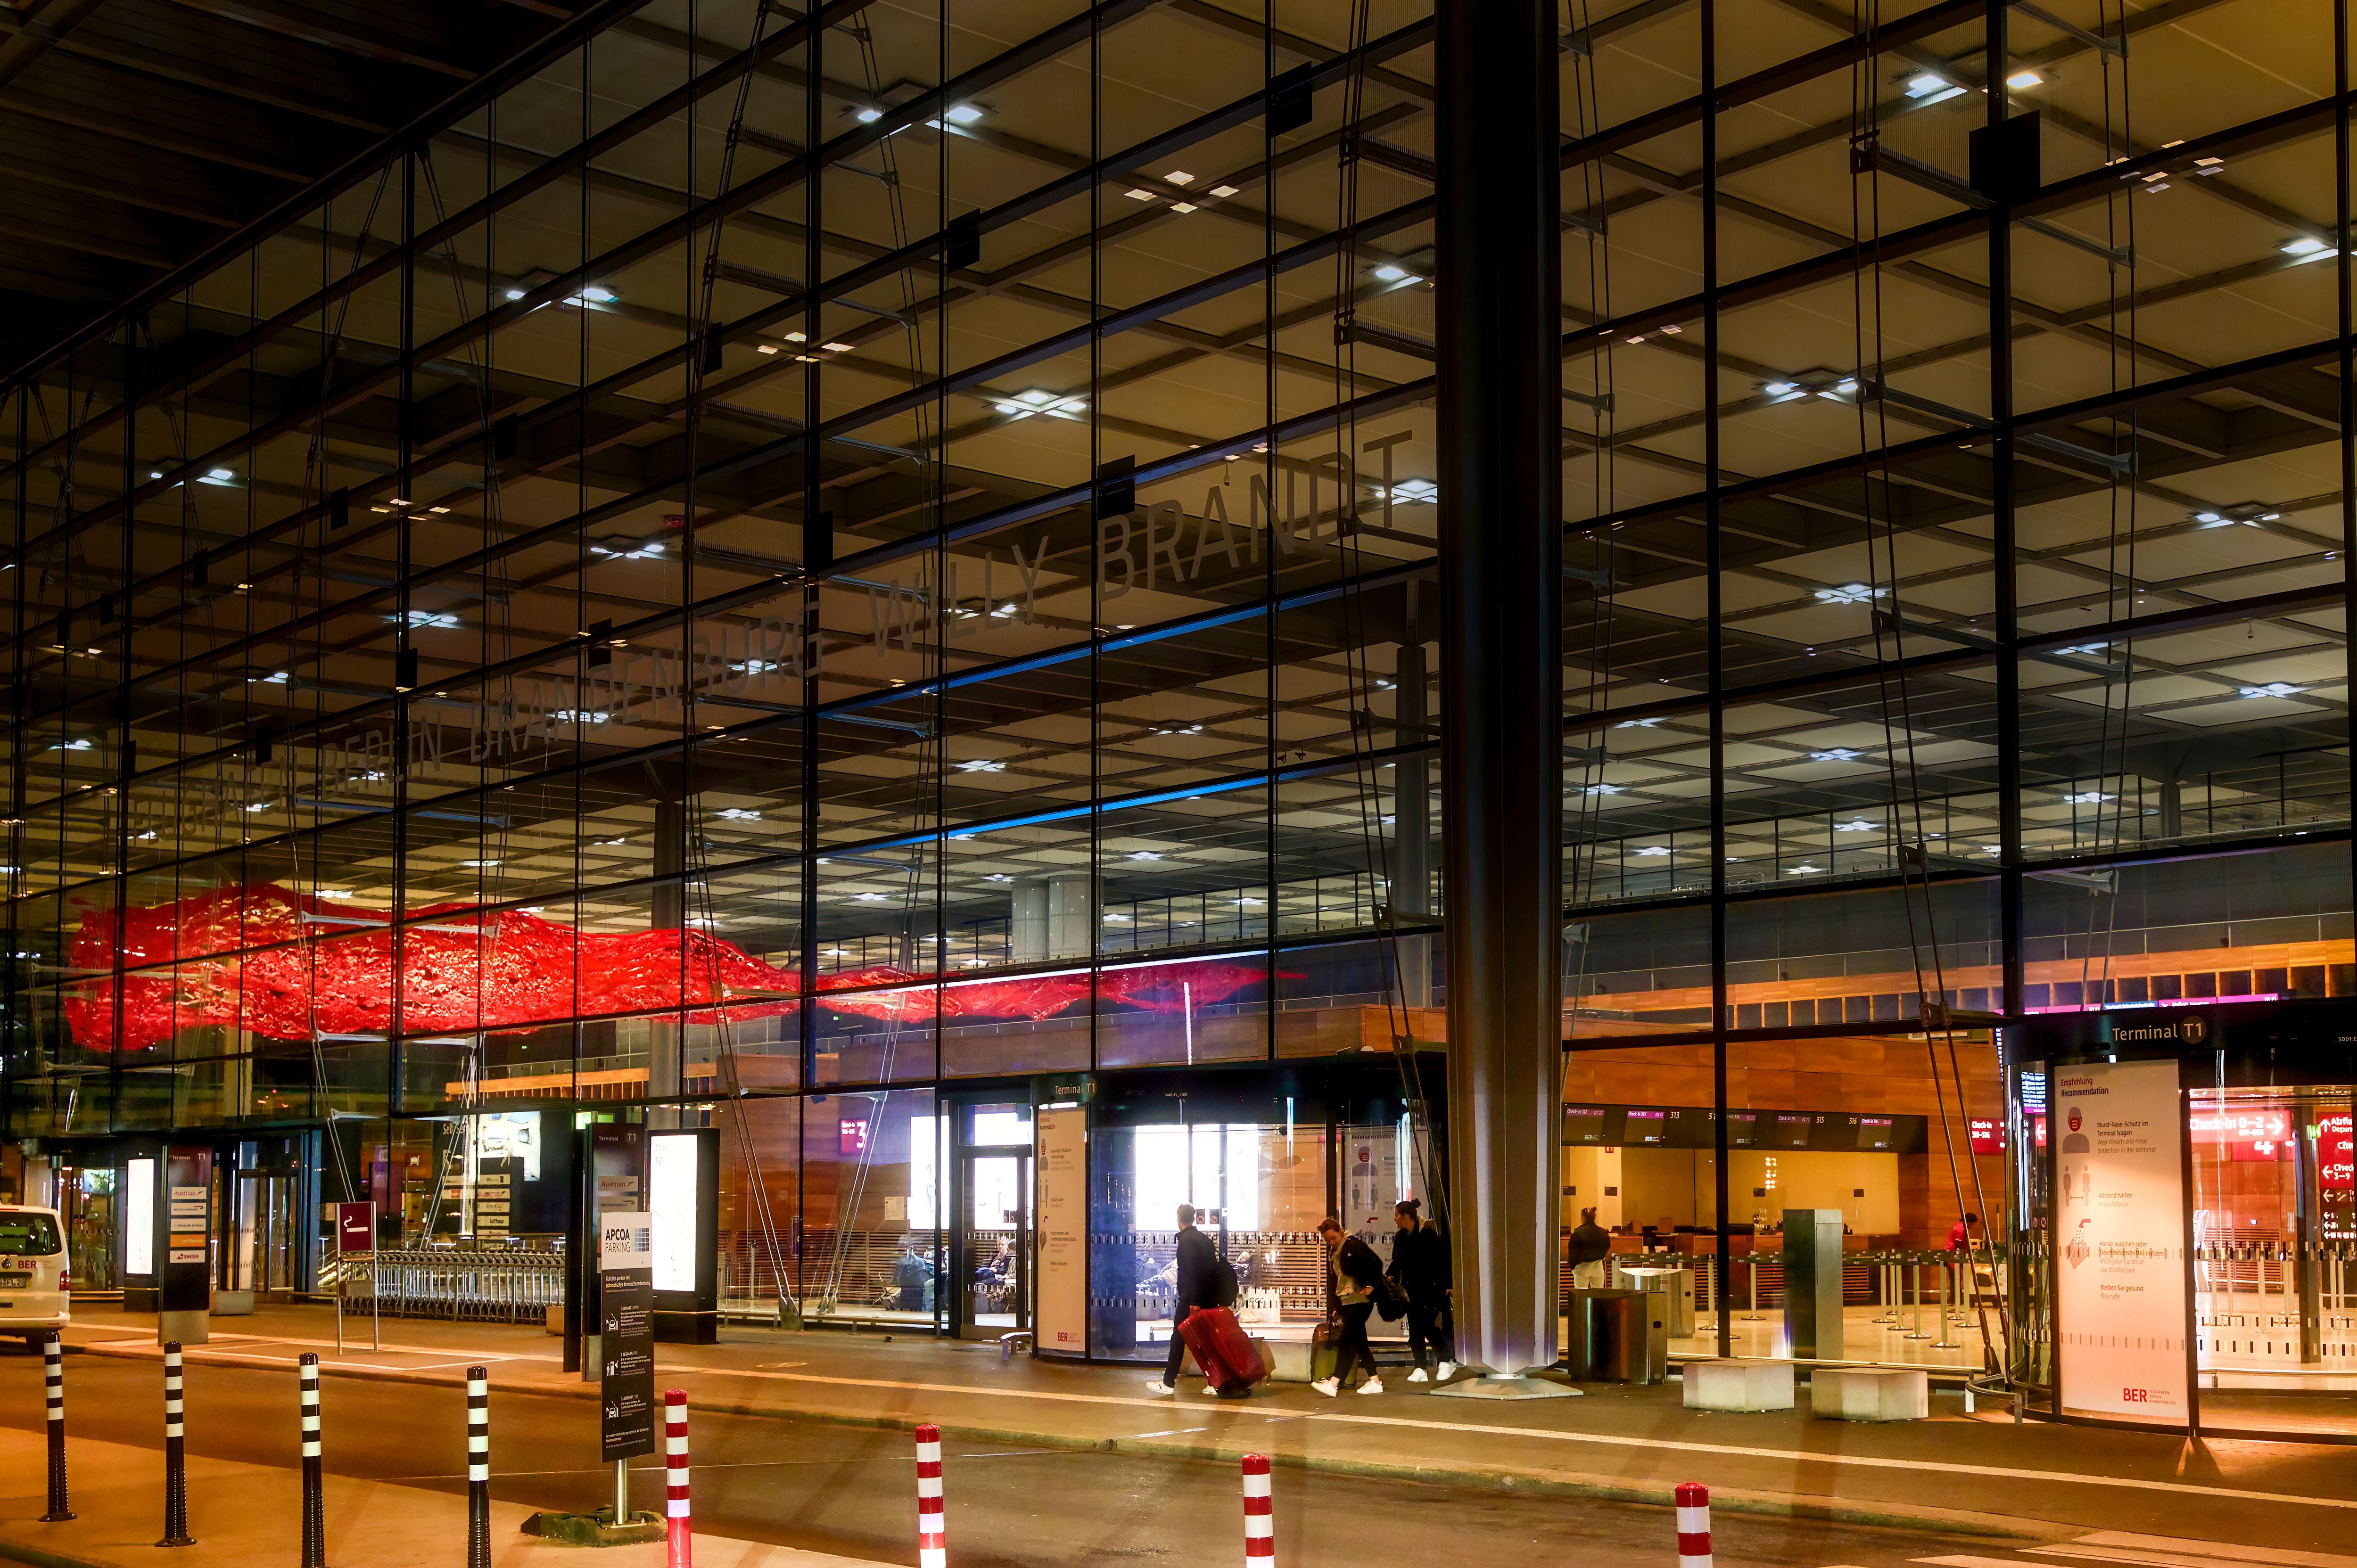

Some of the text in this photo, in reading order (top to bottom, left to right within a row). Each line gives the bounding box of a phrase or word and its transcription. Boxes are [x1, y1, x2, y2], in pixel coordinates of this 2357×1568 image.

[869, 535, 1048, 658] WILLY
[1098, 430, 1412, 602] BRANDT
[2112, 1023, 2201, 1041] Terminal T1
[2061, 1077, 2093, 1087] Empfehlung
[1055, 1083, 1096, 1094] Terminal T1
[2061, 1087, 2109, 1097] Recommendation
[2190, 1117, 2236, 1130] Check-in
[627, 1133, 636, 1141] T1
[857, 1122, 866, 1148] 3
[605, 1228, 630, 1241] APCOA
[605, 1242, 630, 1253] PARKING
[18, 1260, 36, 1269] BER
[1057, 1332, 1068, 1342] BER
[2123, 1388, 2147, 1403] BER
